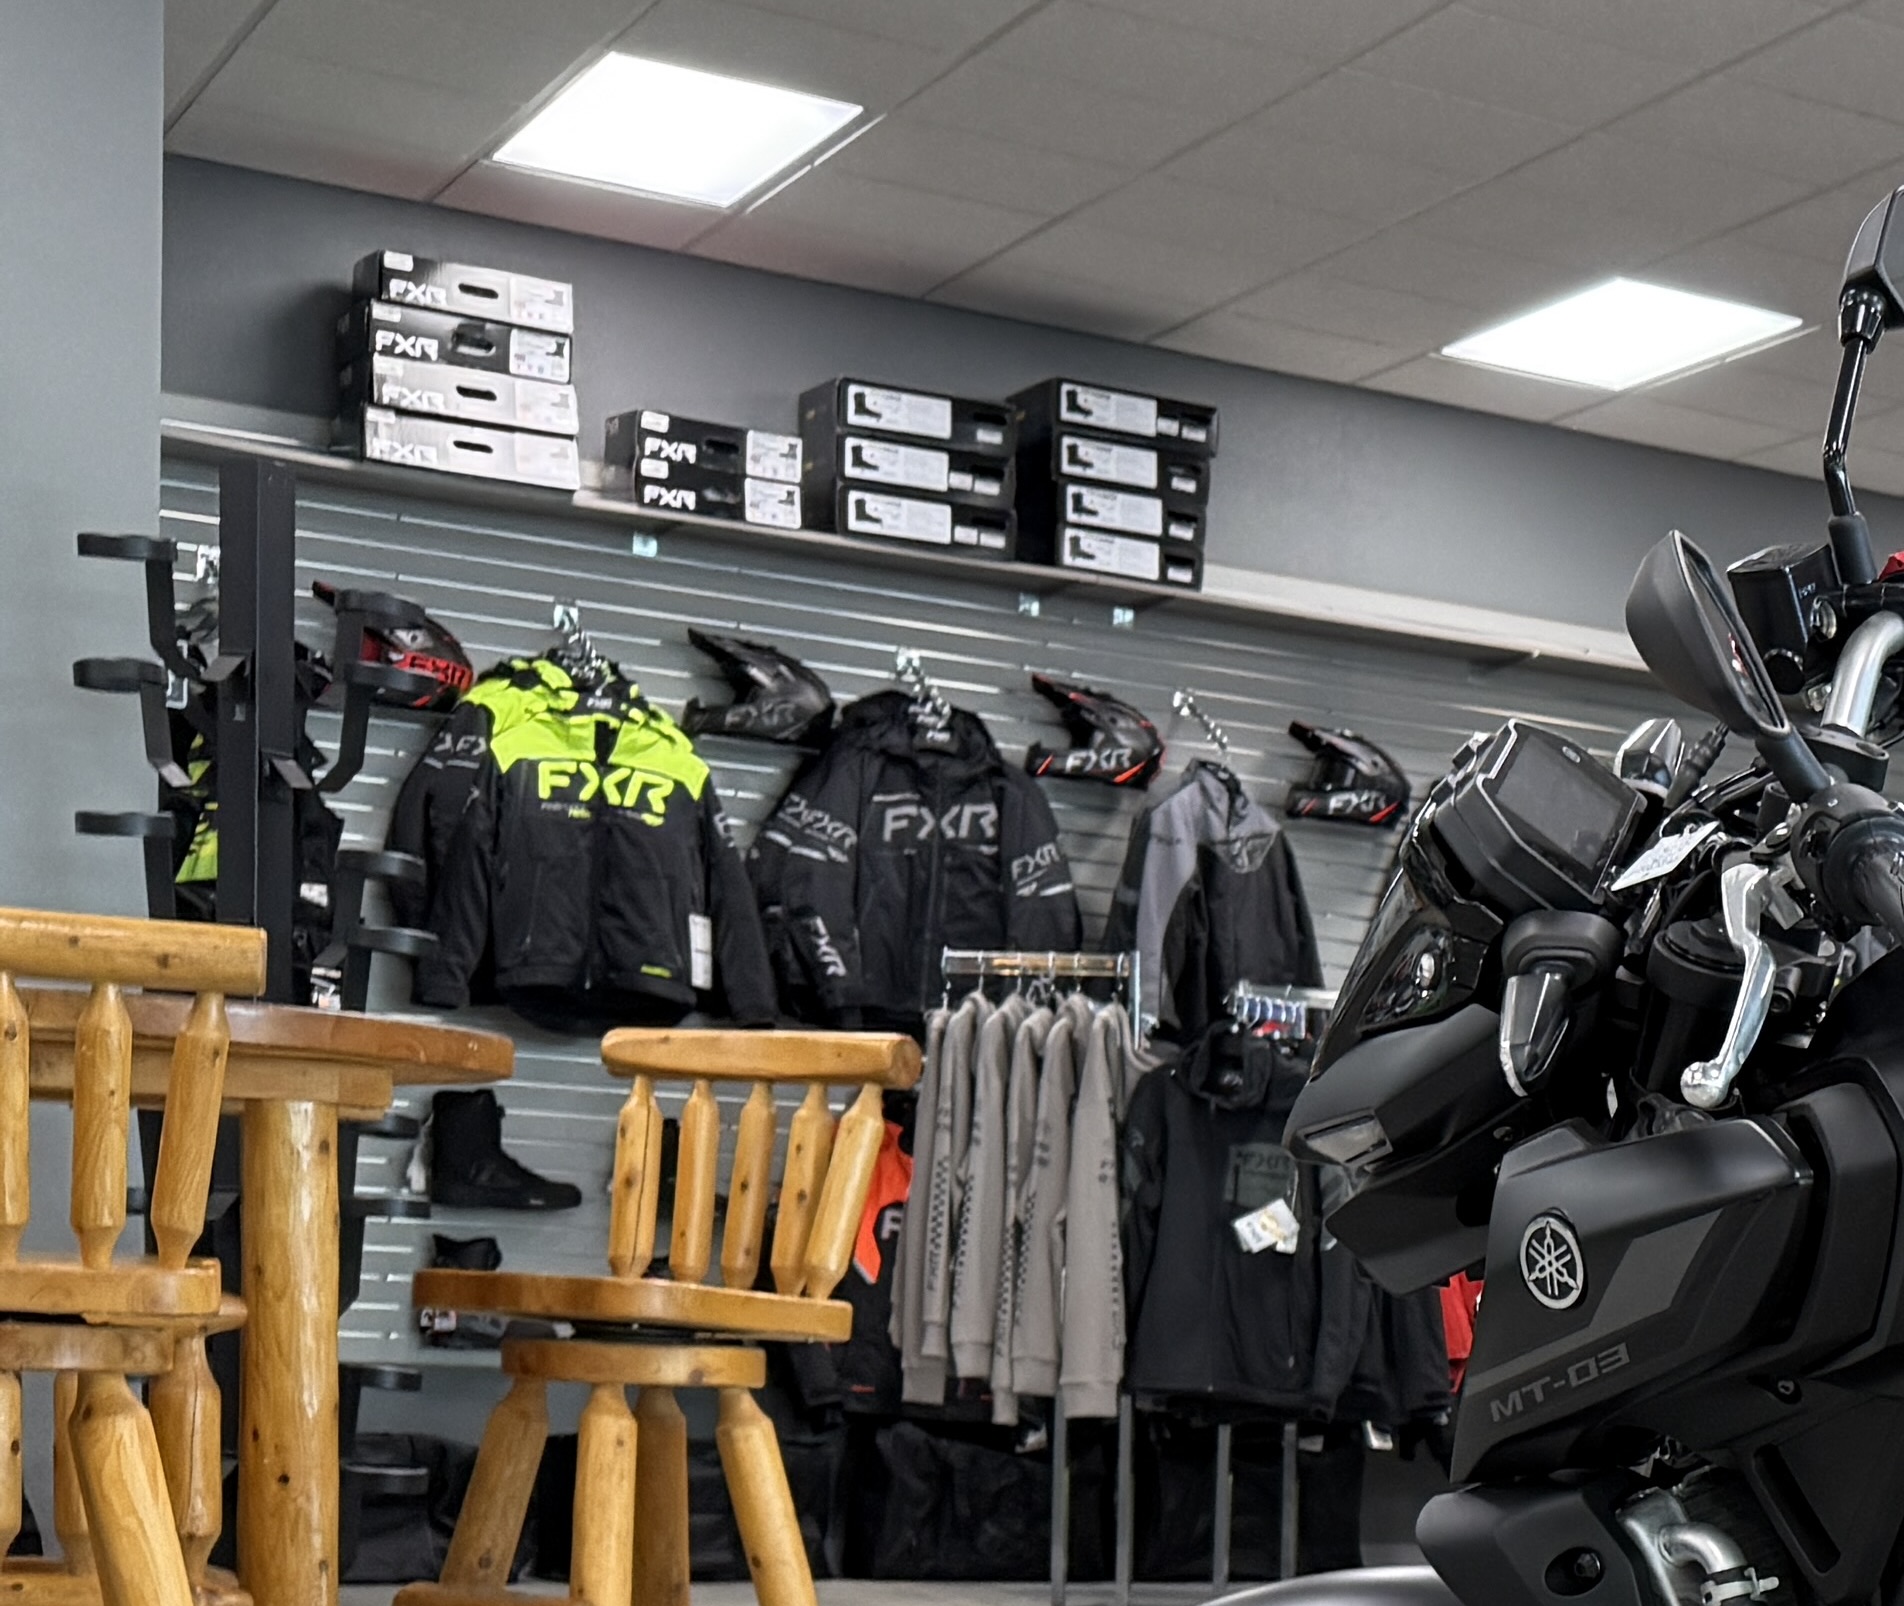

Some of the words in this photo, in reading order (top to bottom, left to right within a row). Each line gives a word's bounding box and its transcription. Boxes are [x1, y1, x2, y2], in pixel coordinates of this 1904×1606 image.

[388, 278, 447, 306] FXR
[376, 329, 438, 361] FXR
[382, 383, 444, 411] FXR
[372, 437, 438, 464] FXR
[643, 436, 697, 464] FXR
[643, 484, 697, 511] FXR
[724, 701, 796, 726] FXR
[1065, 747, 1132, 773] FXR
[538, 760, 675, 814] FXR
[1328, 790, 1389, 816] FXR
[883, 804, 999, 842] FXR
[1011, 841, 1060, 877] FXR
[809, 915, 848, 978] FXR
[1489, 1342, 1630, 1422] MT-03
